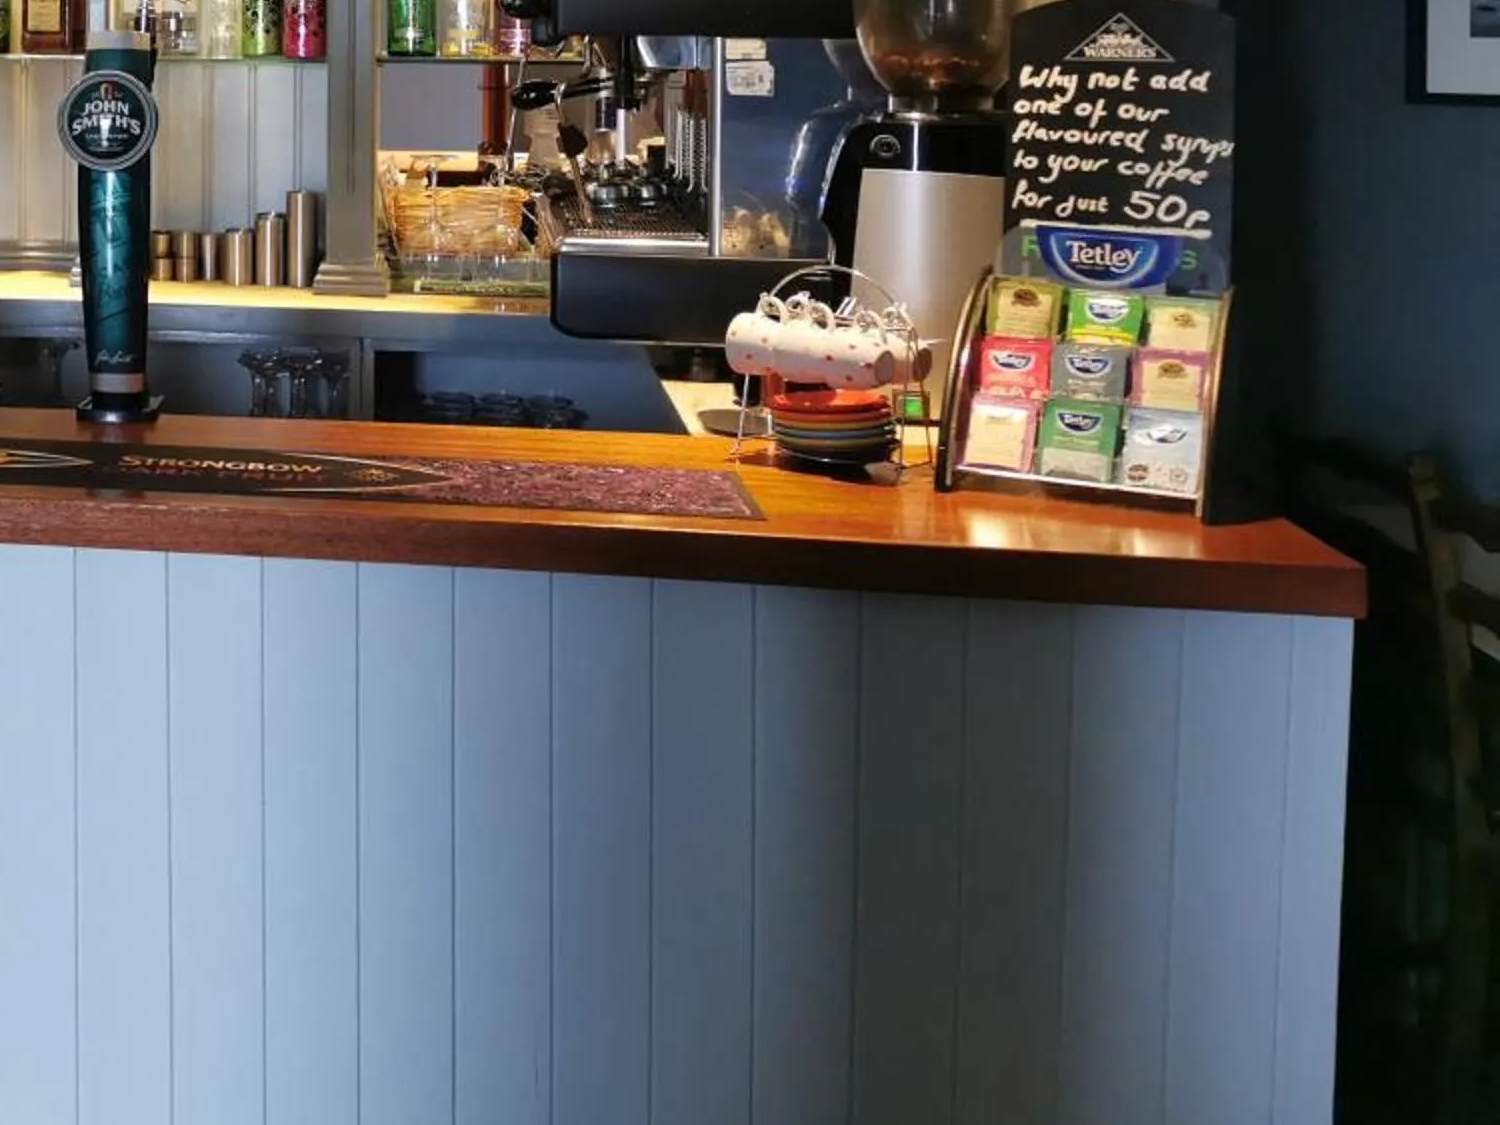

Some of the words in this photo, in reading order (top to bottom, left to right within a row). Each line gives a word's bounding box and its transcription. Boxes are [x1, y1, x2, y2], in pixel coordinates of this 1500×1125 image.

[1019, 64, 1079, 104] Why
[1086, 66, 1140, 92] not
[1149, 68, 1212, 93] add
[82, 99, 130, 116] JOHN
[1012, 97, 1062, 116] one
[1074, 98, 1108, 128] of
[1116, 102, 1171, 123] our
[1011, 119, 1149, 154] flavoured
[1012, 149, 1039, 170] to
[1037, 153, 1110, 184] your
[1116, 157, 1210, 190] coffee
[1011, 178, 1052, 210] for
[1055, 193, 1110, 218] just
[1123, 189, 1213, 228] 50p
[1065, 239, 1143, 274] Tetley
[117, 454, 324, 473] STRONGBOW
